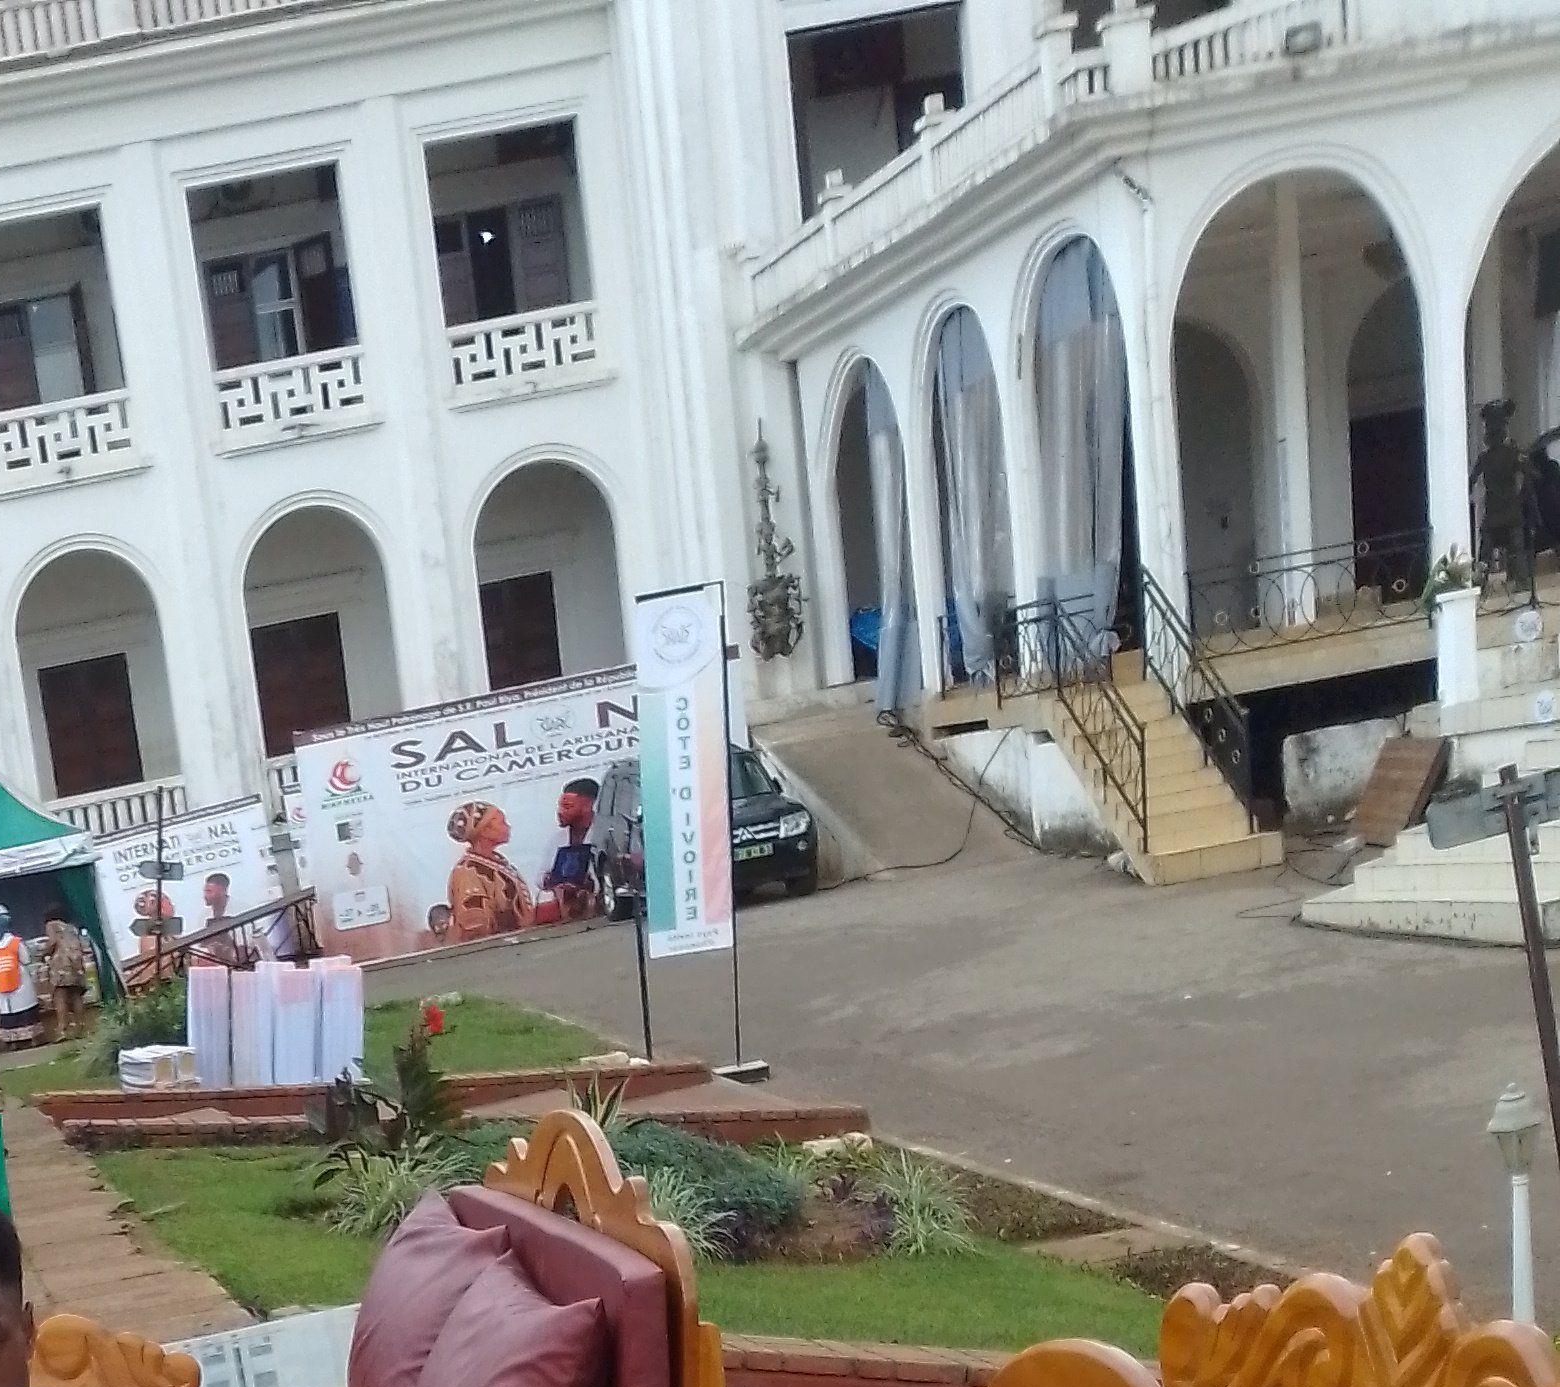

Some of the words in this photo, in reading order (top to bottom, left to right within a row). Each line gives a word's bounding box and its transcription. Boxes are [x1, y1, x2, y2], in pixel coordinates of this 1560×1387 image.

[476, 696, 497, 709] Paul
[523, 682, 568, 700] Président
[395, 749, 521, 780] INTERNATIONAL
[525, 744, 544, 755] DE
[400, 774, 443, 793] DU
[455, 735, 639, 781] CAMEROUN
